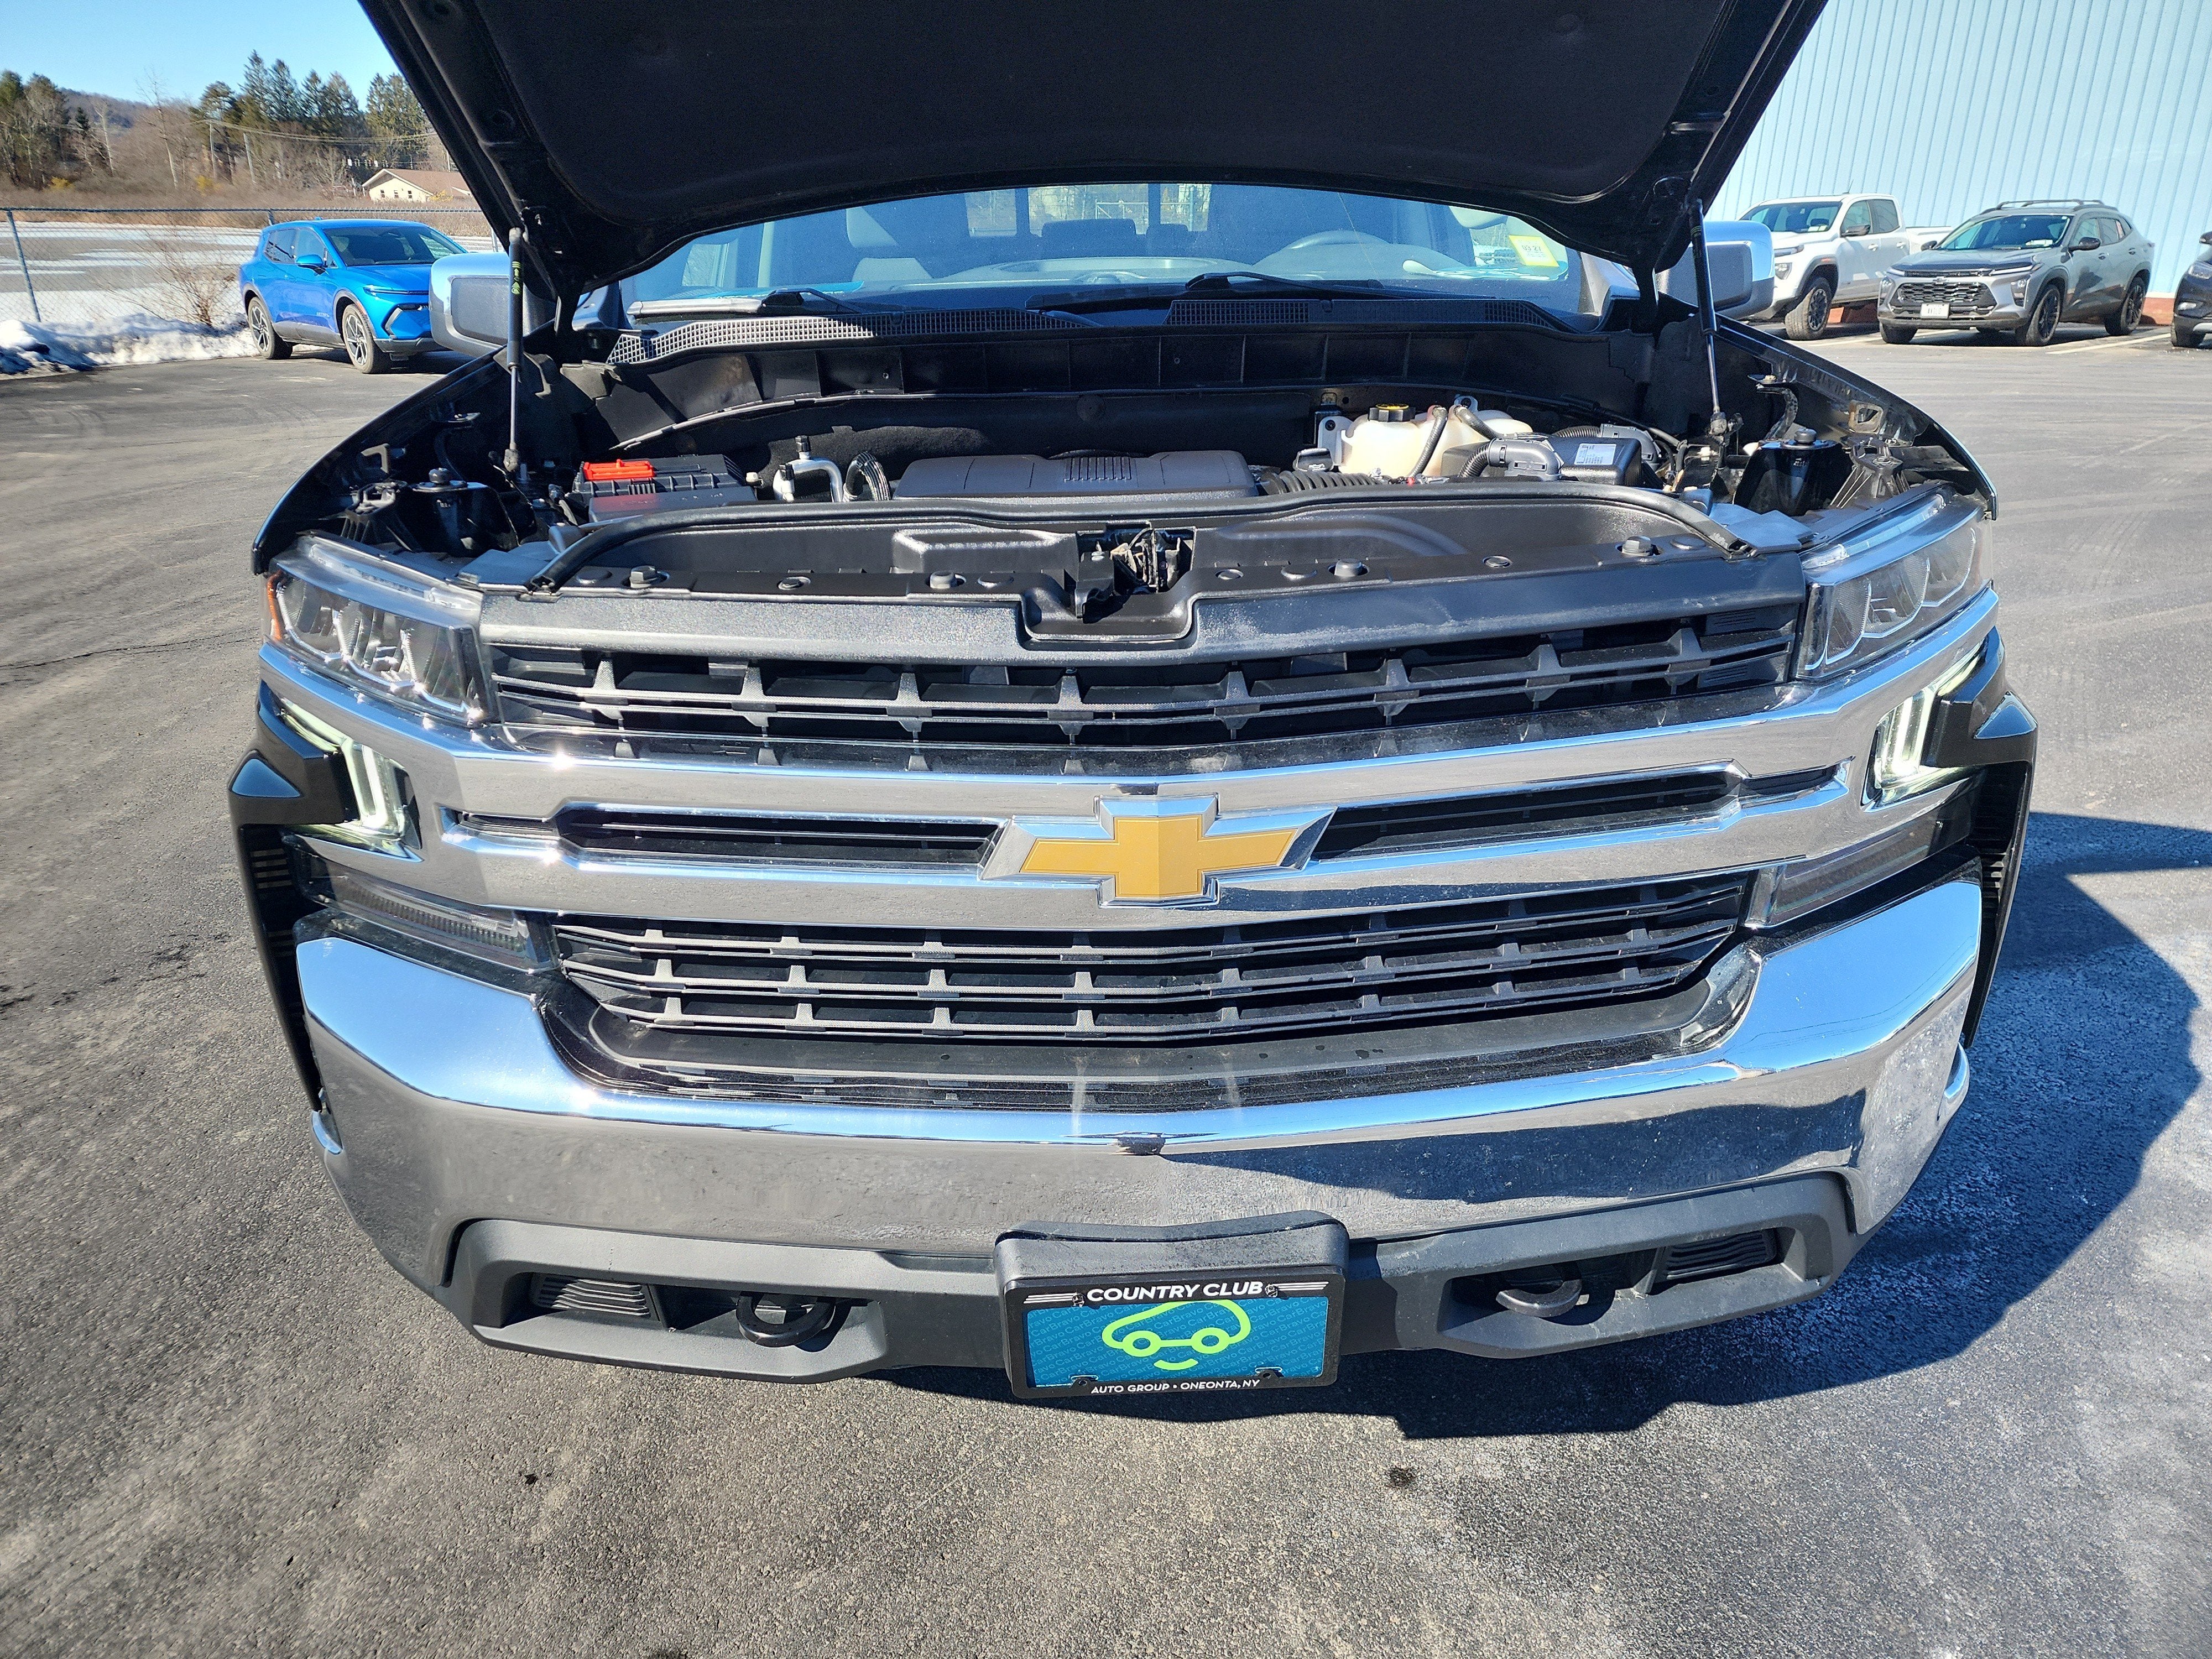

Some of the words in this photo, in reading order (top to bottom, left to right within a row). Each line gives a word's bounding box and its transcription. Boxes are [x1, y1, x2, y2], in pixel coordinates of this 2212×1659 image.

[1087, 1284, 1201, 1302] COUNTRY
[1203, 1281, 1264, 1296] CLUB
[1125, 1309, 1175, 1330] CarBravo
[1277, 1301, 1326, 1322] CarBravo
[1029, 1332, 1065, 1348] rBravo
[1065, 1312, 1114, 1334] CarBravo
[1031, 1316, 1079, 1337] CarBravo
[1056, 1347, 1104, 1366] CarBravo
[1154, 1308, 1203, 1329] CarBravo
[1260, 1317, 1310, 1338] CarBravo
[1044, 1332, 1092, 1352] CarBravo
[1101, 1358, 1149, 1376] CarBravo
[1250, 1302, 1300, 1323] CarBravo
[1238, 1335, 1287, 1355] CarBravo
[1287, 1321, 1326, 1337] CarBra
[1221, 1350, 1271, 1369] CarBravo
[1271, 1332, 1321, 1352] CarBravo
[1041, 1361, 1088, 1380] CarBravo
[1091, 1385, 1124, 1394] AUTO
[1127, 1383, 1170, 1392] GROUP
